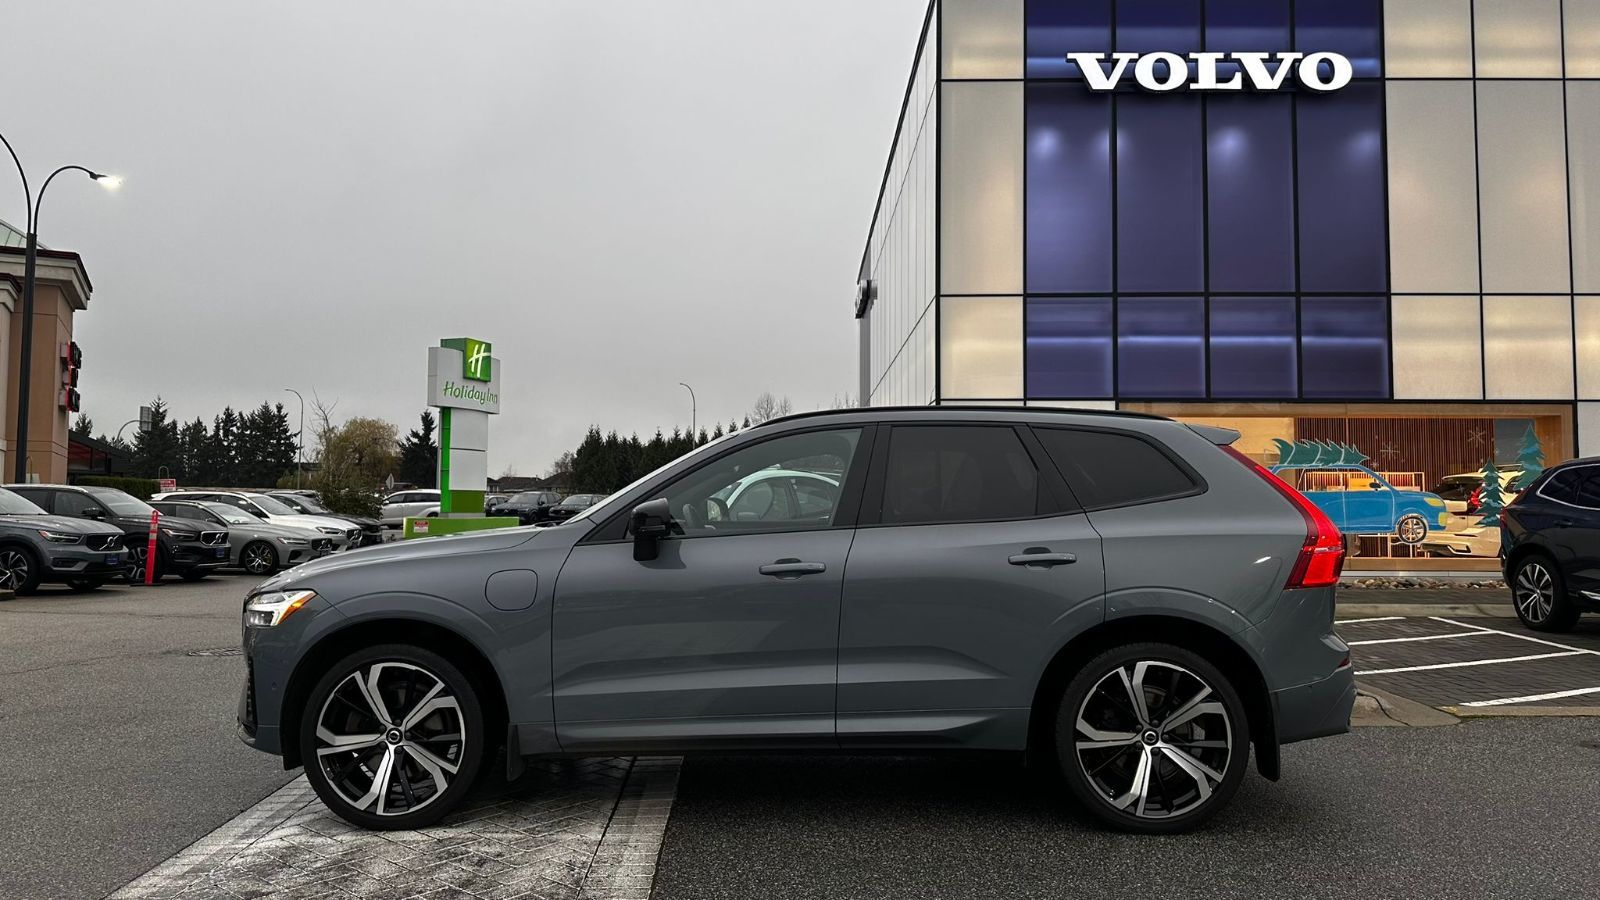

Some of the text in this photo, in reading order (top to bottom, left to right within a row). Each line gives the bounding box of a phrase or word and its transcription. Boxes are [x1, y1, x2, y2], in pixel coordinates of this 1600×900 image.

[1066, 52, 1353, 91] VOLVO
[468, 343, 491, 378] H
[443, 381, 498, 405] Holiday Inn
